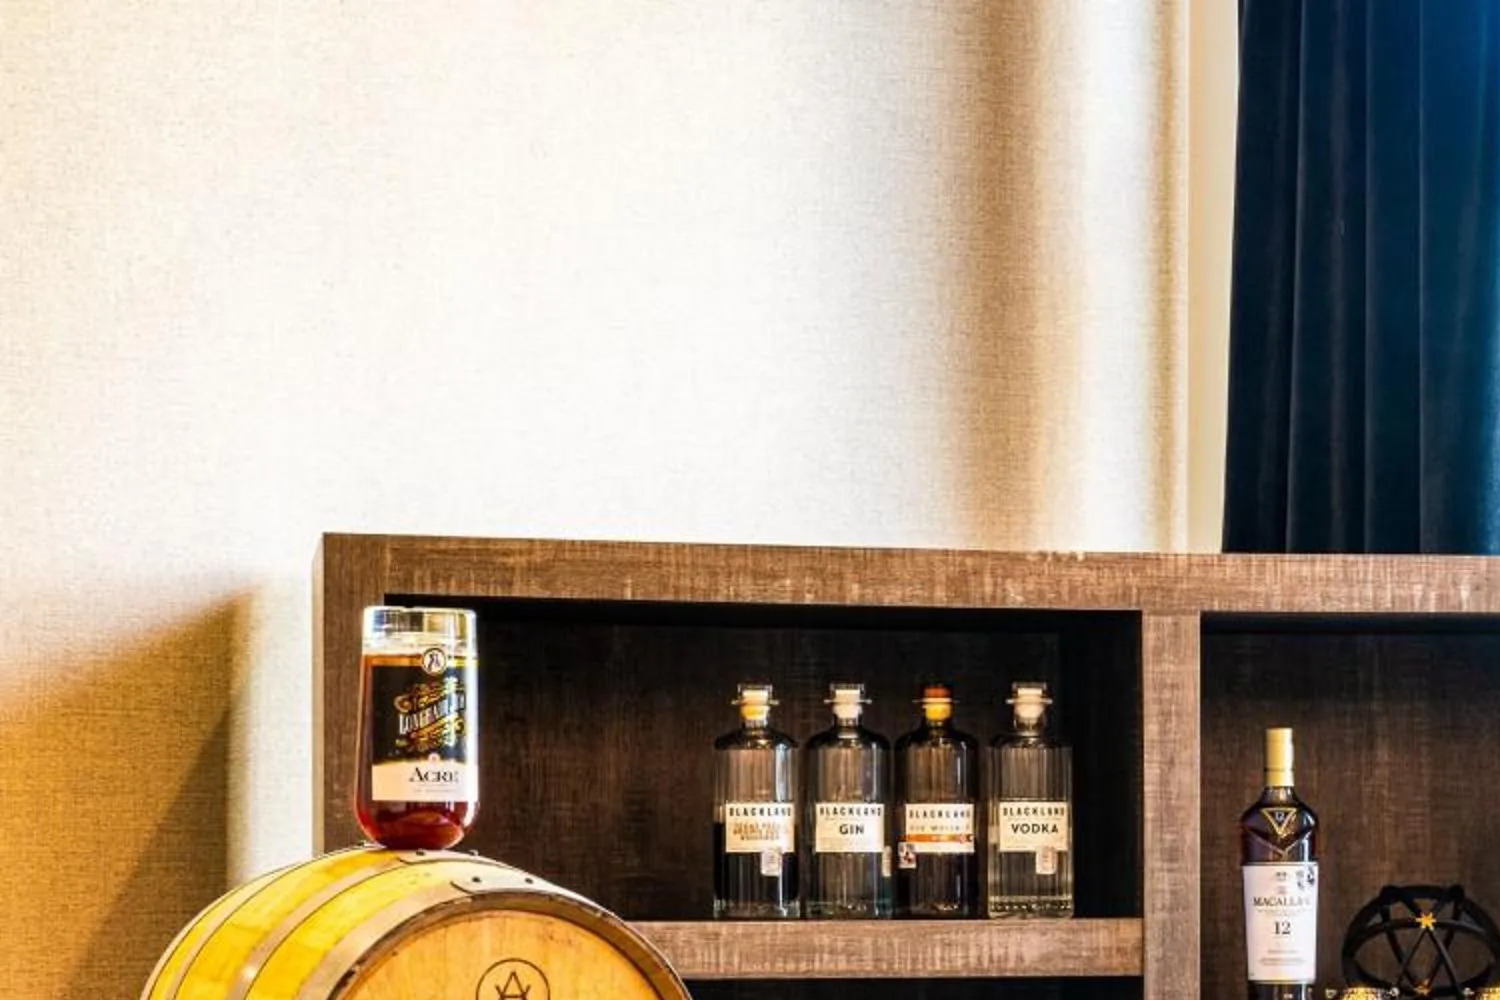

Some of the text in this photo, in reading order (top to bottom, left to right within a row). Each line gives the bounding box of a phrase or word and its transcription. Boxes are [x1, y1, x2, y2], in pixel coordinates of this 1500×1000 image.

[839, 823, 864, 835] GIN
[1011, 823, 1059, 835] VODKA
[1273, 921, 1291, 935] 12
